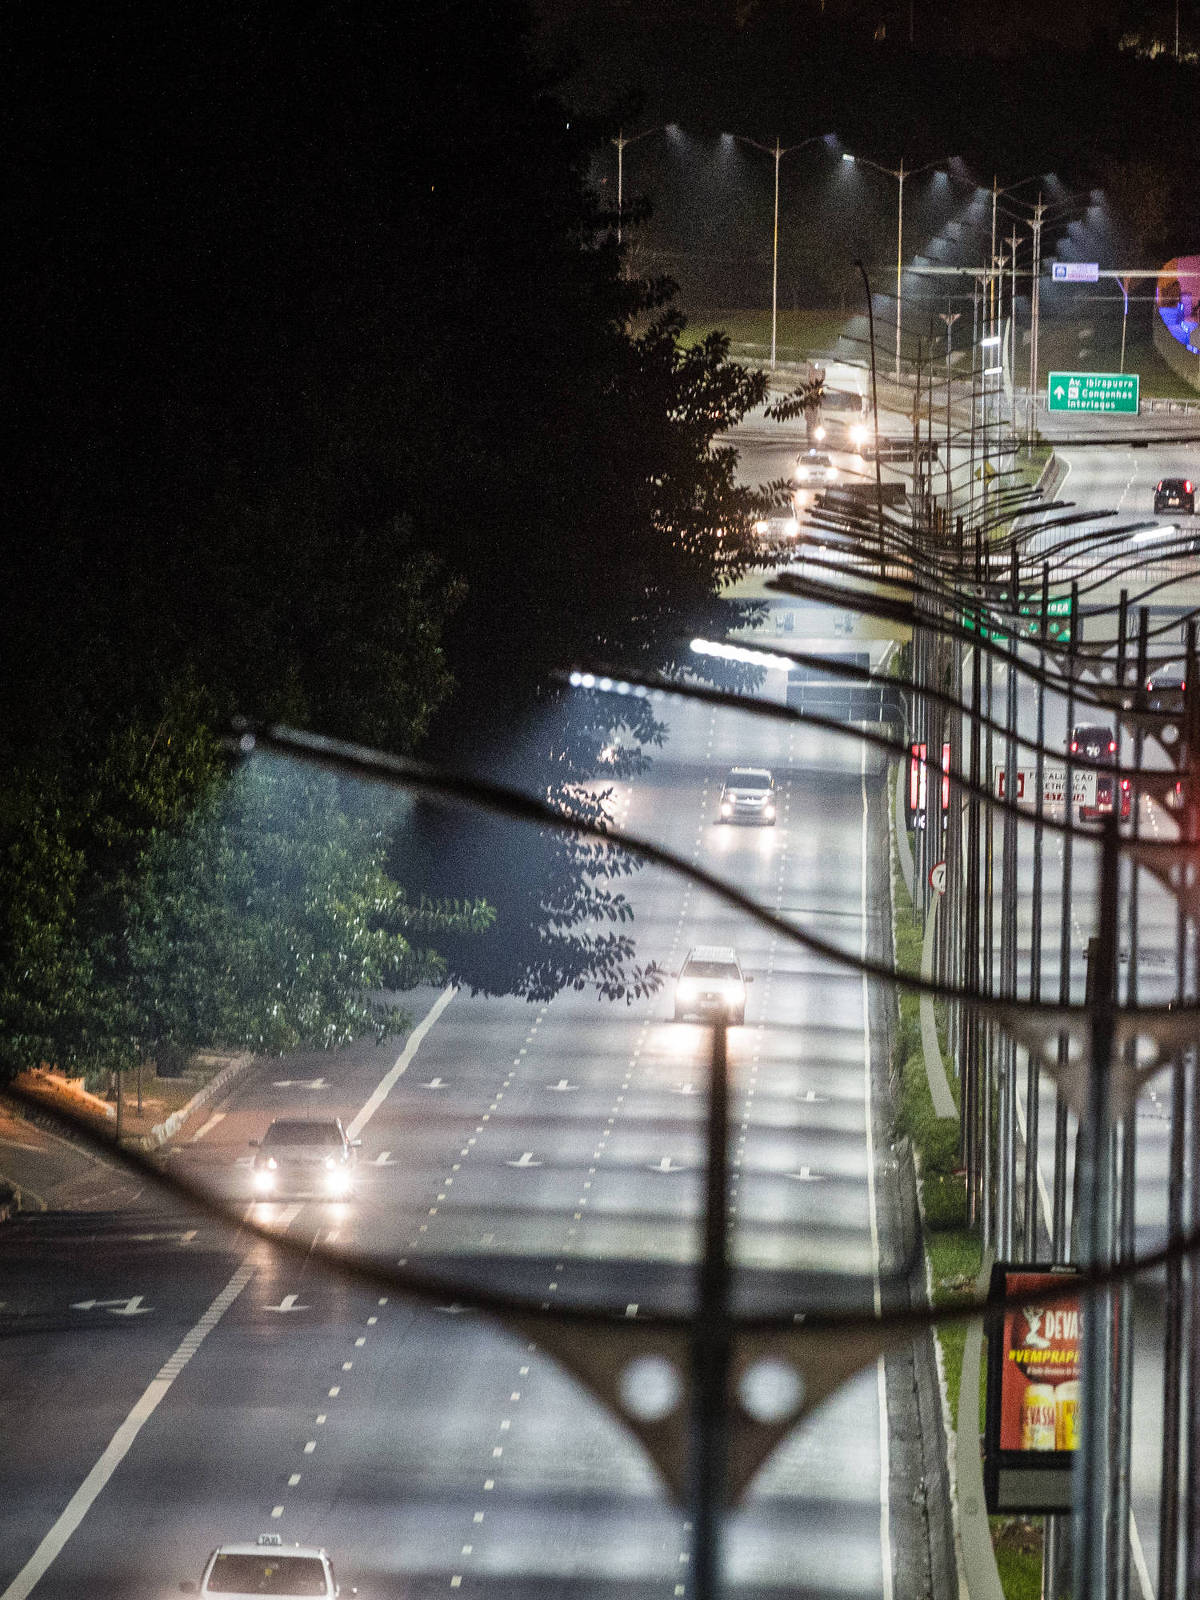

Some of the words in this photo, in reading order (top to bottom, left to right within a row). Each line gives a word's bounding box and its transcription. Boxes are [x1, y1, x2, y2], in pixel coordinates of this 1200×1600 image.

[1086, 378, 1134, 388] Ibirapuera
[1082, 389, 1132, 400] Congonhas
[1067, 400, 1116, 411] Interlagos
